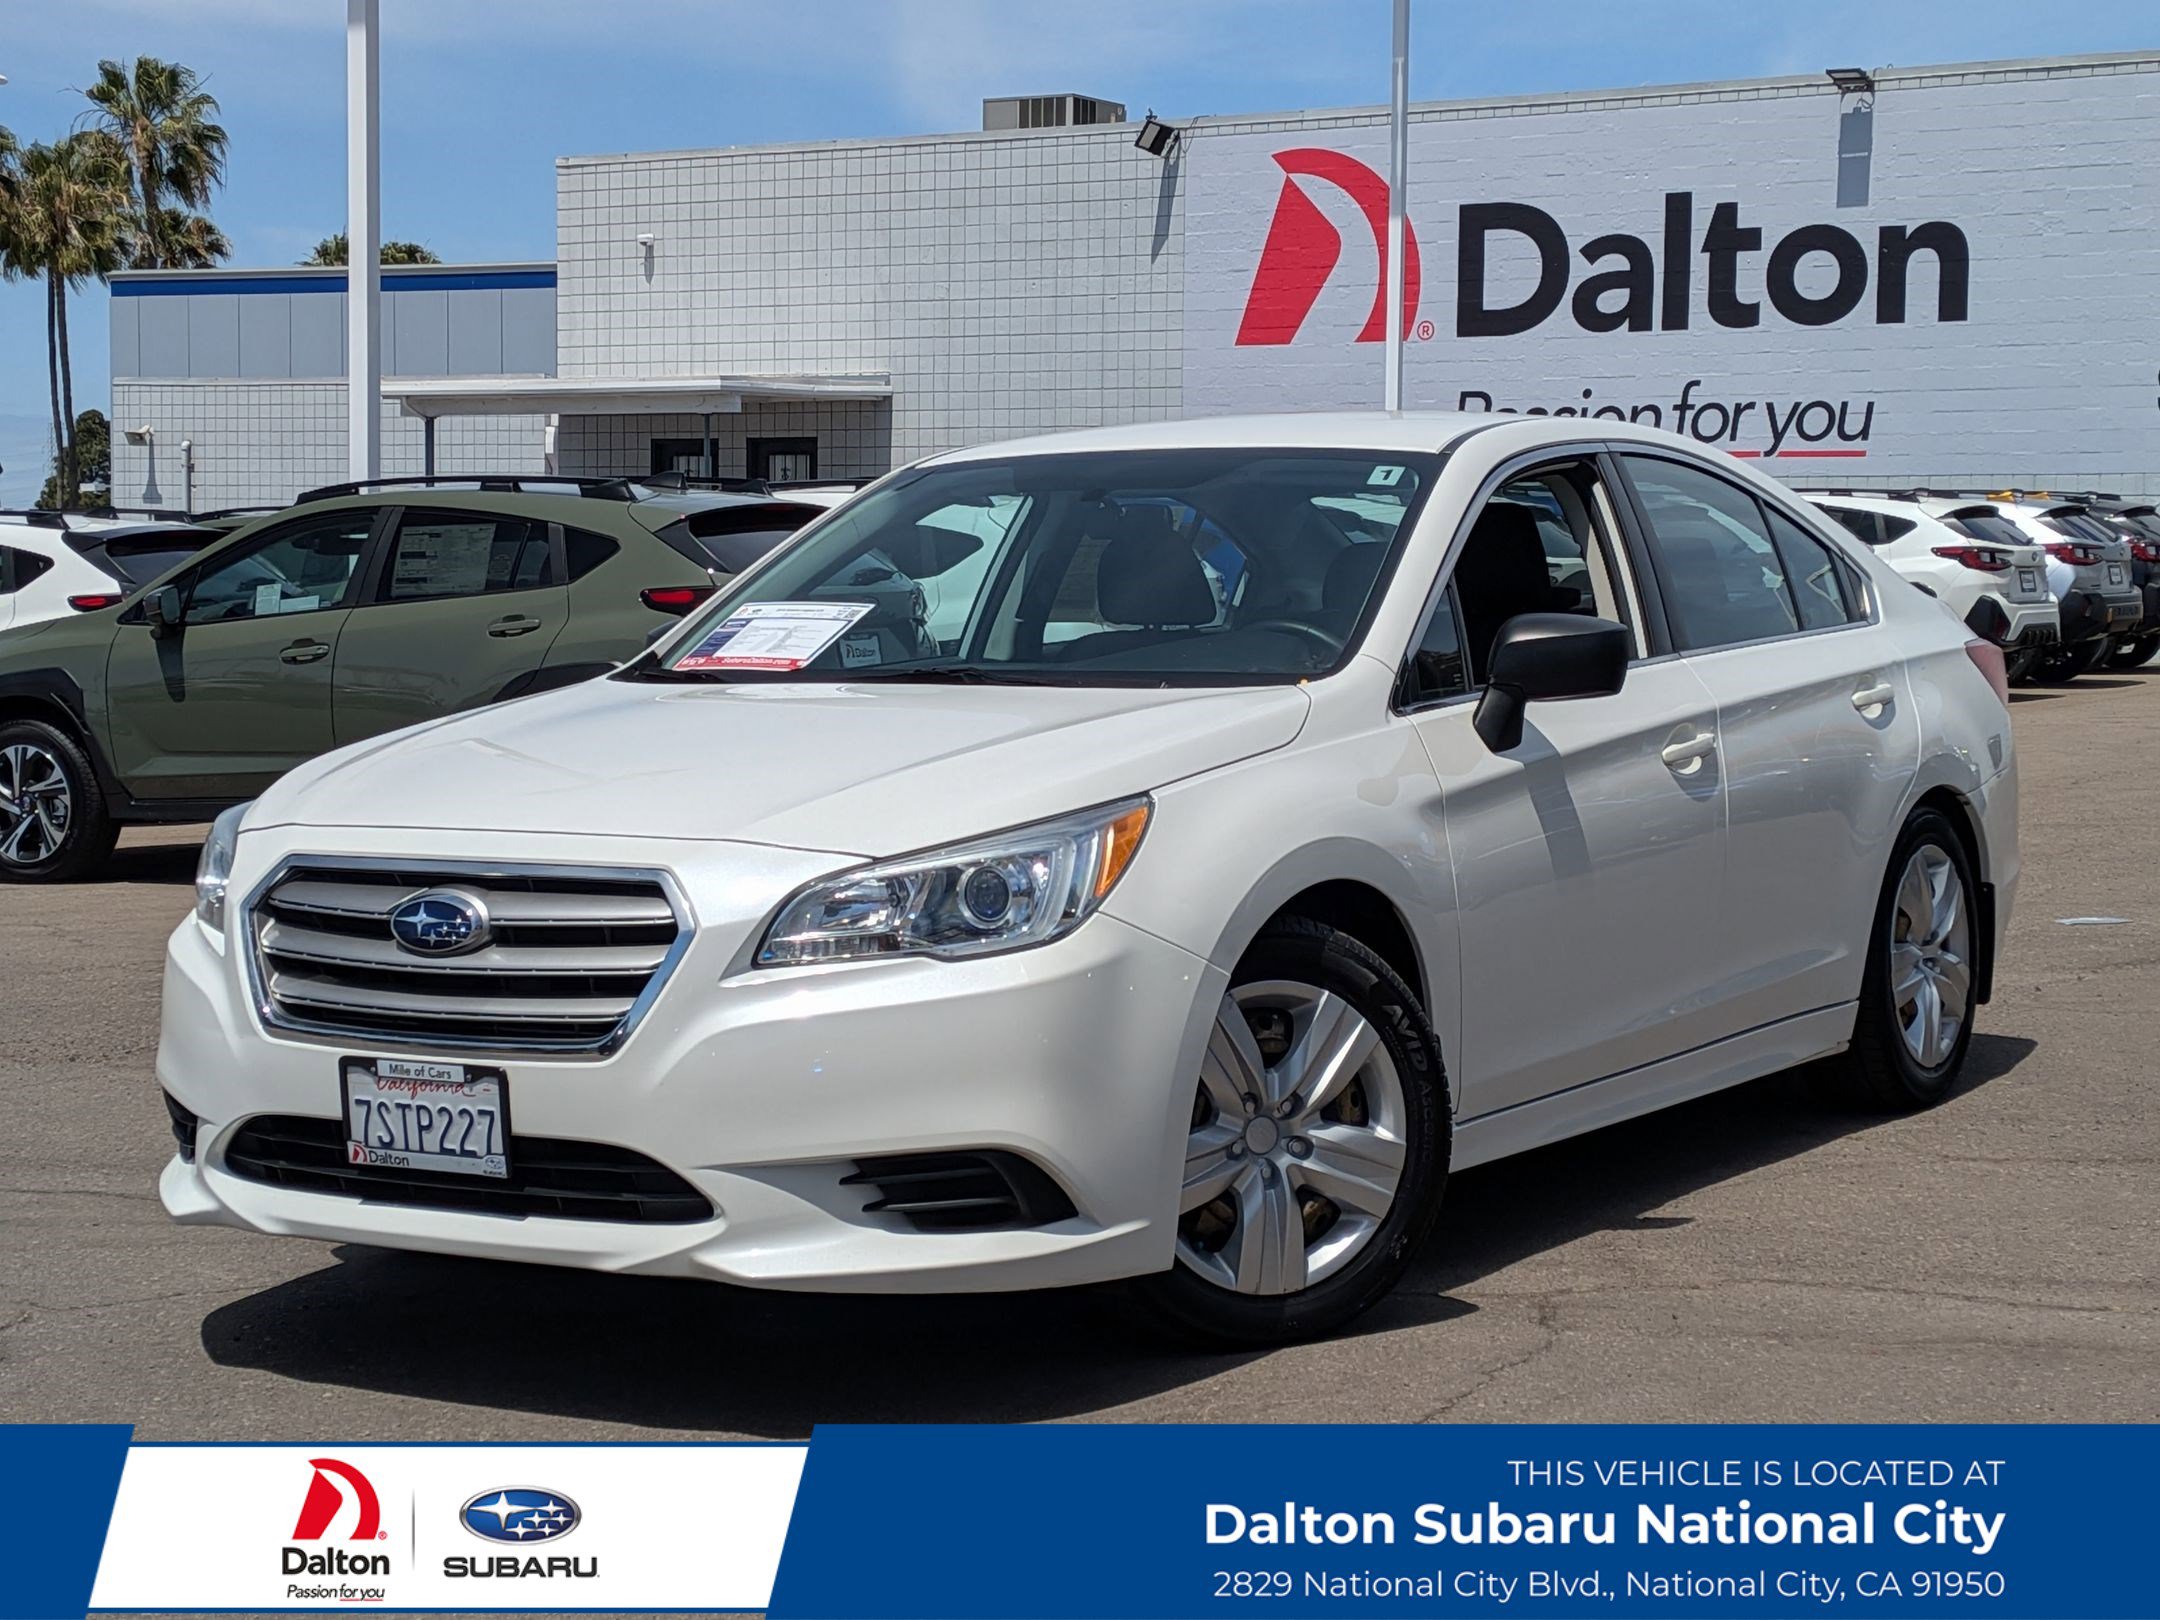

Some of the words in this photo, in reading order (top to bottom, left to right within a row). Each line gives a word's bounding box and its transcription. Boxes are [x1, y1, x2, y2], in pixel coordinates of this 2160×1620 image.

[1457, 191, 1970, 338] Dalton
[1672, 380, 1756, 443] for
[1763, 400, 1875, 458] you
[389, 1063, 411, 1076] Mile
[414, 1066, 426, 1077] of
[427, 1066, 452, 1079] Cars
[354, 1098, 495, 1157] 7STP227
[369, 1150, 410, 1167] Dalton
